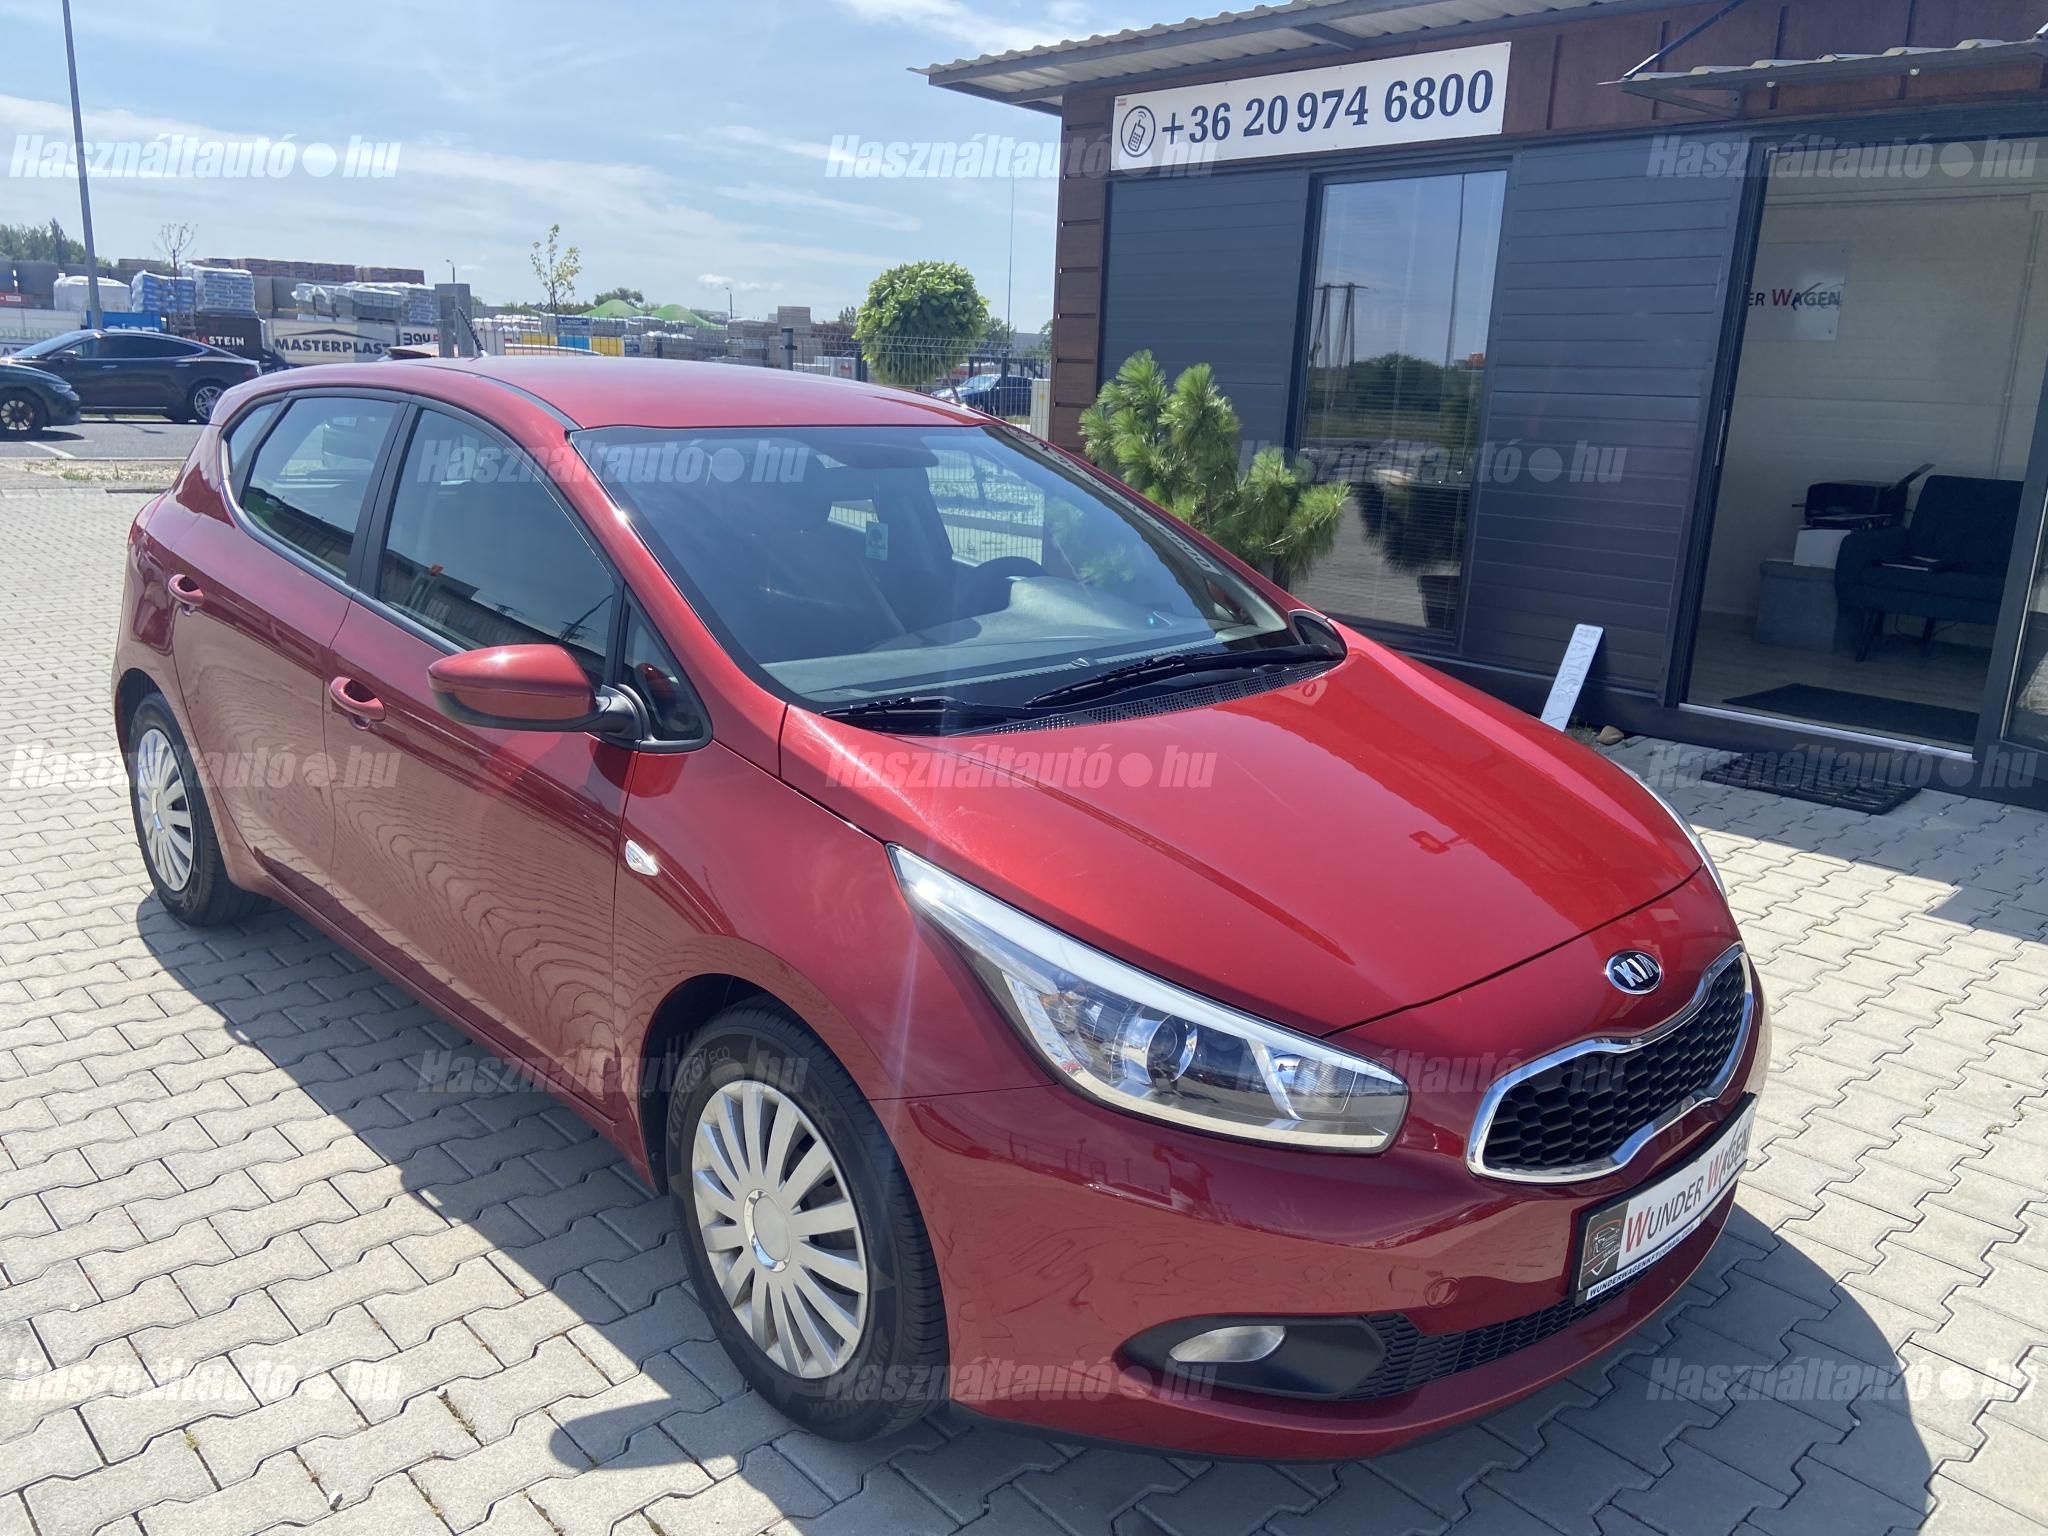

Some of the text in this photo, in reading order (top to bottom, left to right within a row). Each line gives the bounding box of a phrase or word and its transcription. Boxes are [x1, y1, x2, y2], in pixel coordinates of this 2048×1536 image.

[1162, 102, 1231, 145] +36
[1383, 69, 1494, 123] 6800
[275, 338, 392, 355] MASTERPLAST
[1613, 954, 1659, 987] KIA
[1625, 1175, 1704, 1253] WUNDER
